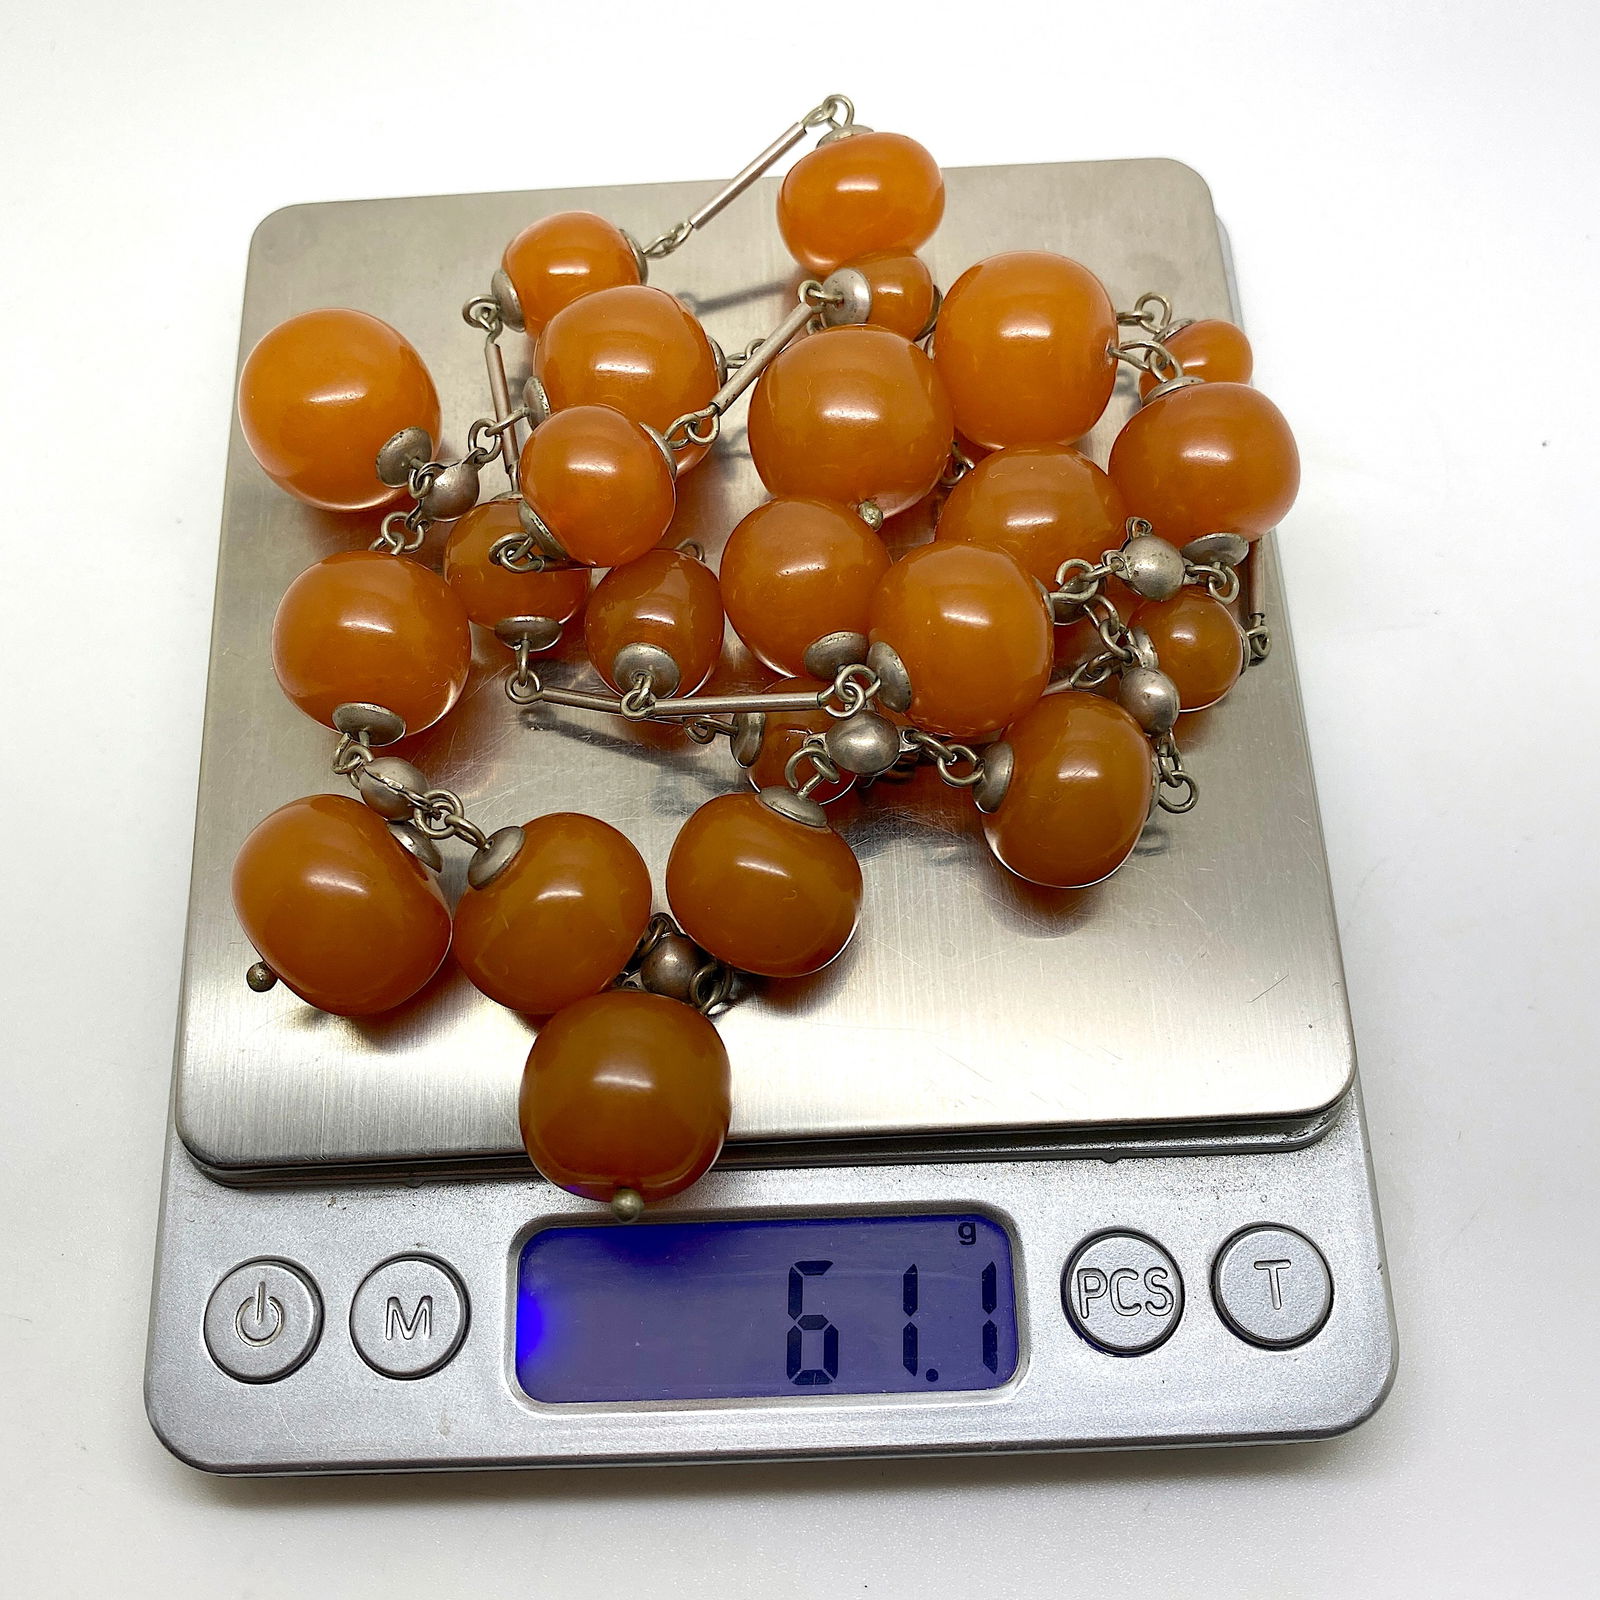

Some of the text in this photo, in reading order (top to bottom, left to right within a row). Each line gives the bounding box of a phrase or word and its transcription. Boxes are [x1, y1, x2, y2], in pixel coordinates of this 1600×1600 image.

[958, 1221, 977, 1246] g
[1076, 1266, 1174, 1319] PCS
[1253, 1259, 1291, 1310] T
[385, 1295, 433, 1341] M
[786, 1260, 997, 1386] 61.1
